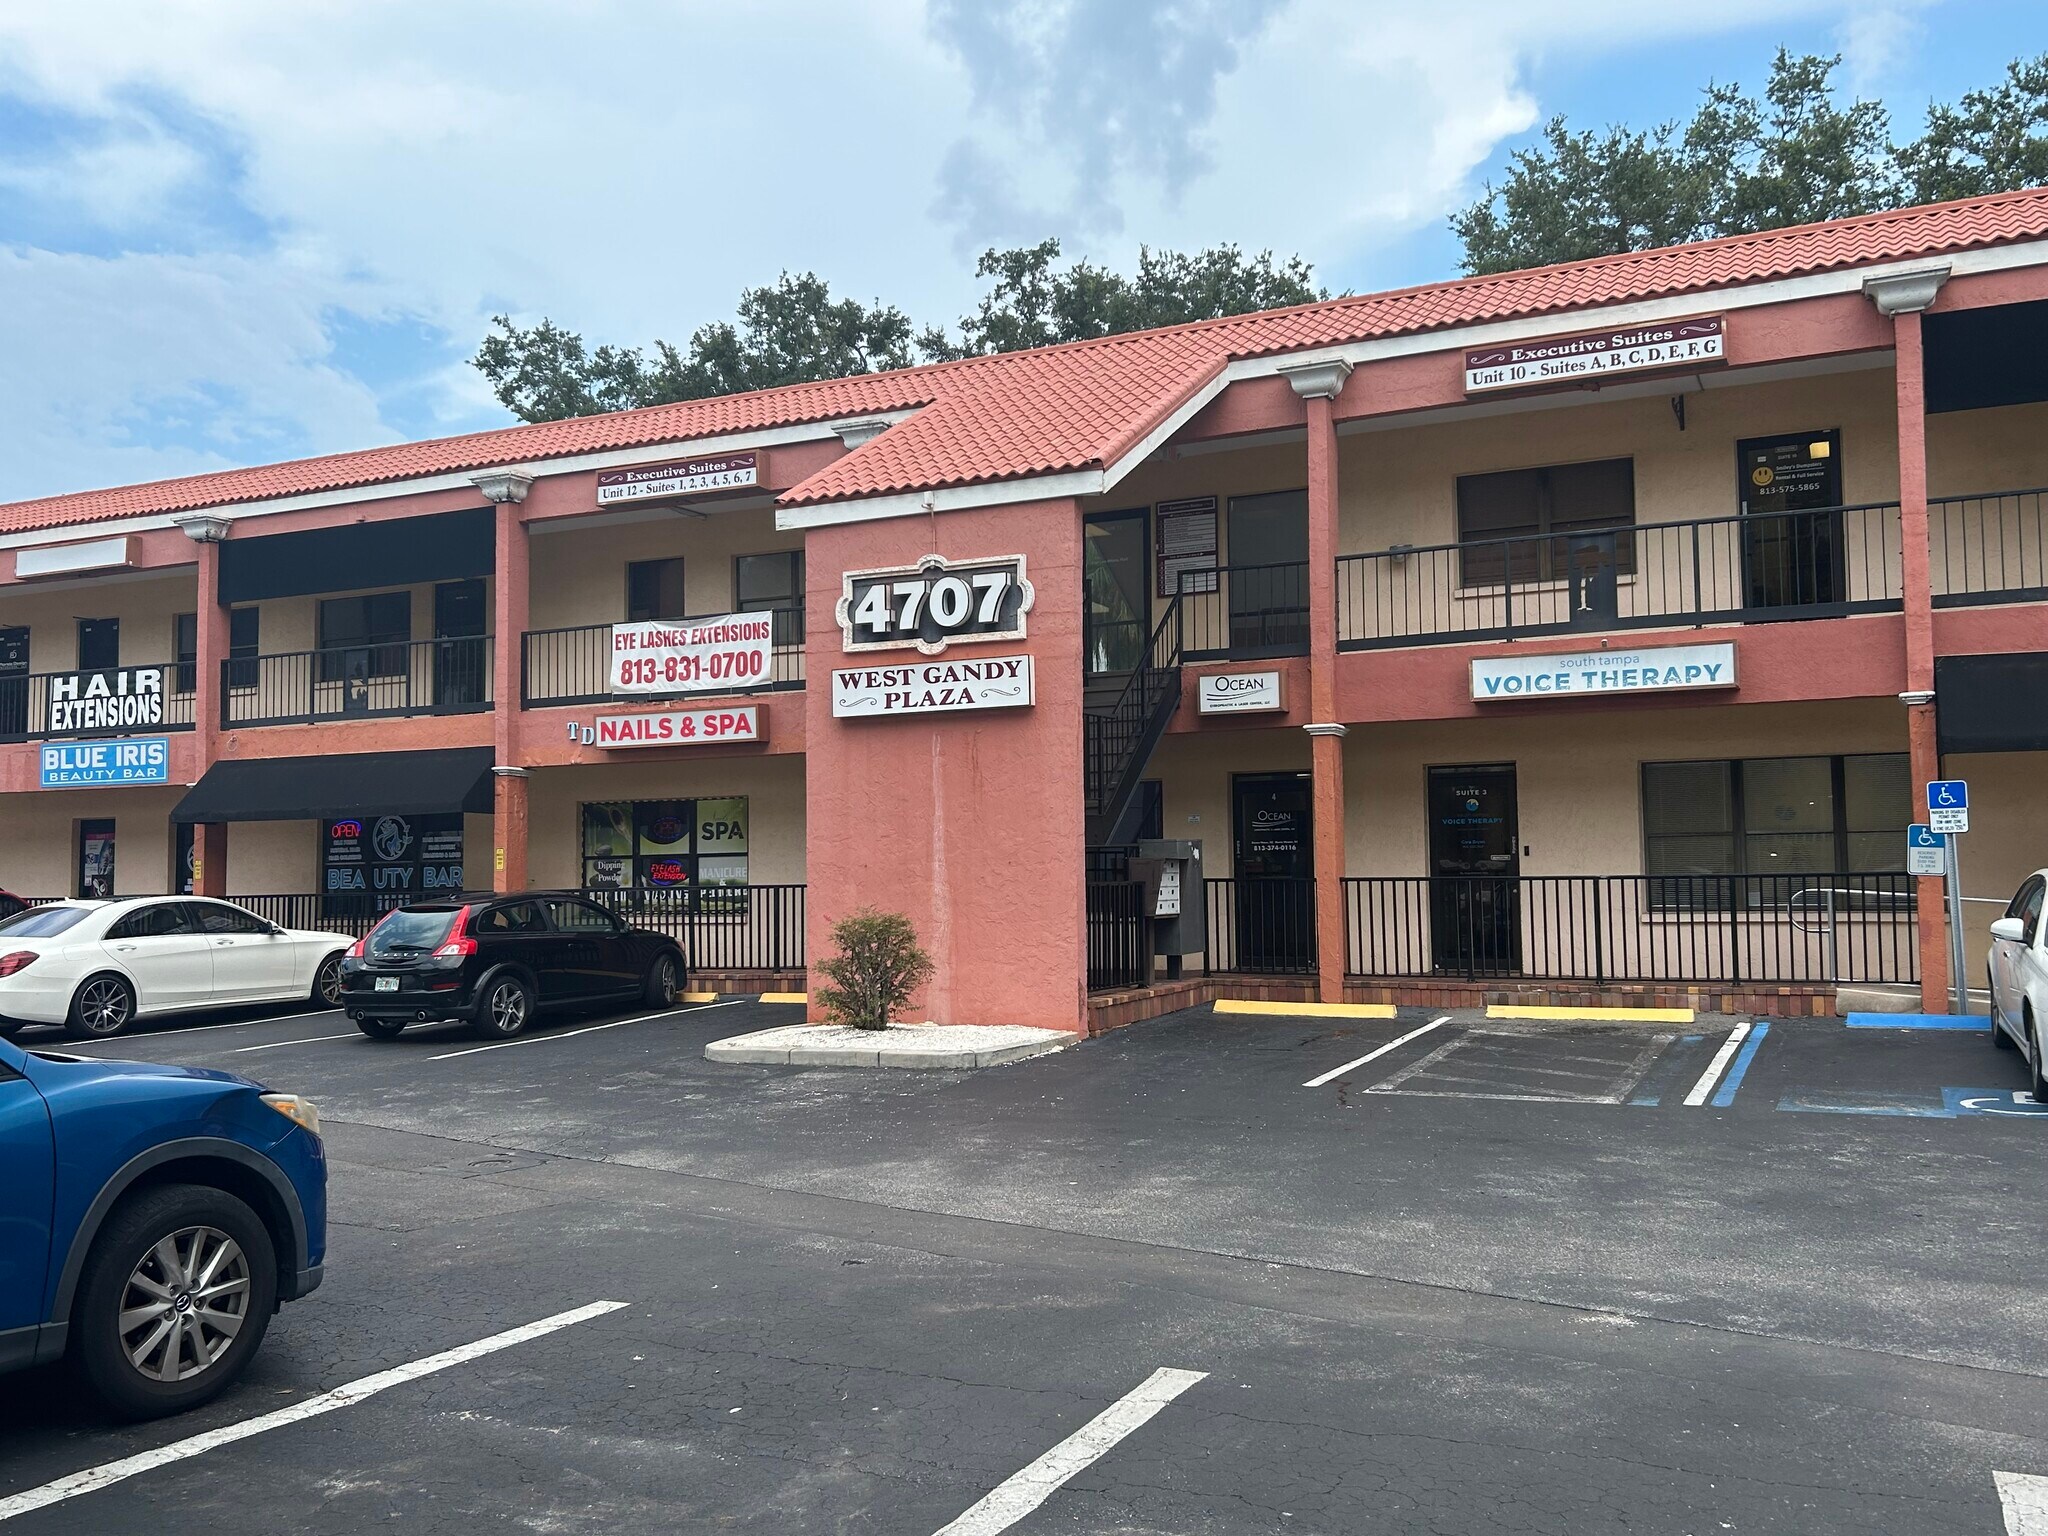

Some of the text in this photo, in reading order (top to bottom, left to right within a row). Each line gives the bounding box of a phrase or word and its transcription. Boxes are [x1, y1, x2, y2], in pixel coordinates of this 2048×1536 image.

[1511, 329, 1674, 362] Executive Suites
[1472, 369, 1505, 386] Unit
[1510, 366, 1526, 380] 10
[1540, 359, 1586, 378] Suites
[1704, 340, 1716, 353] G
[626, 461, 727, 482] Executive Suites
[602, 487, 623, 499] Unit
[627, 485, 637, 496] 12
[646, 481, 675, 494] Suites
[745, 471, 751, 481] 7
[1760, 483, 1820, 495] 813-575-5865
[854, 572, 1011, 633] 4707
[615, 621, 769, 651] EYE LASHES EXTENSIONS
[621, 650, 763, 685] 813-831-0700
[1560, 654, 1640, 668] south tampa
[53, 669, 160, 701] HAIR
[838, 660, 1022, 690] WEST GANDY
[1484, 663, 1723, 695] VOICE THERAPY
[884, 687, 975, 709] PLAZA
[51, 693, 161, 730] EXTENSIONS
[600, 717, 673, 742] NAILS
[680, 716, 696, 738] &
[703, 713, 752, 736] SPA
[45, 744, 163, 770] BLUE IRIS
[50, 768, 157, 781] BEAUTY BAR
[331, 824, 360, 838] OPEN
[701, 821, 744, 840] SPA
[1468, 817, 1504, 825] THERAPY
[423, 866, 463, 887] BAR
[598, 862, 625, 871] Dipping
[598, 873, 622, 882] Powder
[700, 867, 747, 878] MANICURE
[719, 878, 726, 886] &
